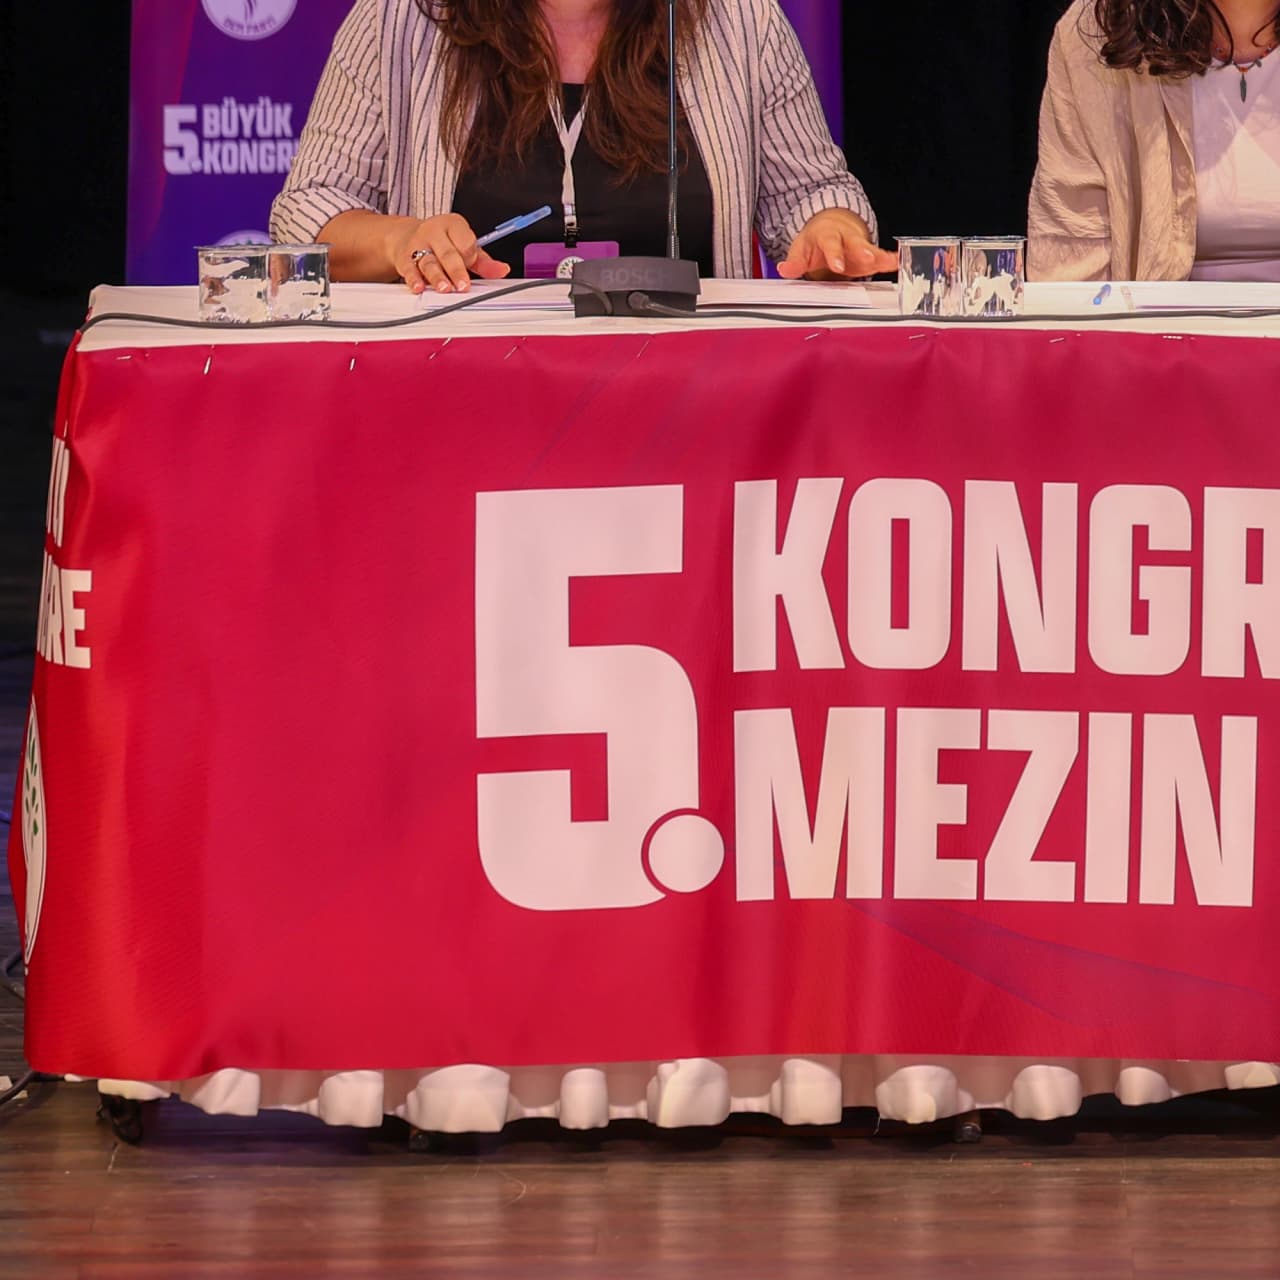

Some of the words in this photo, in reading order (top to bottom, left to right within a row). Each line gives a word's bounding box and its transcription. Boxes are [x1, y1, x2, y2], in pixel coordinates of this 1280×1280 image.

[164, 105, 203, 175] 5.
[203, 97, 293, 138] BÜYÜK
[203, 139, 299, 174] KONGR
[475, 484, 725, 912] 5.
[733, 706, 1258, 907] MEZIN
